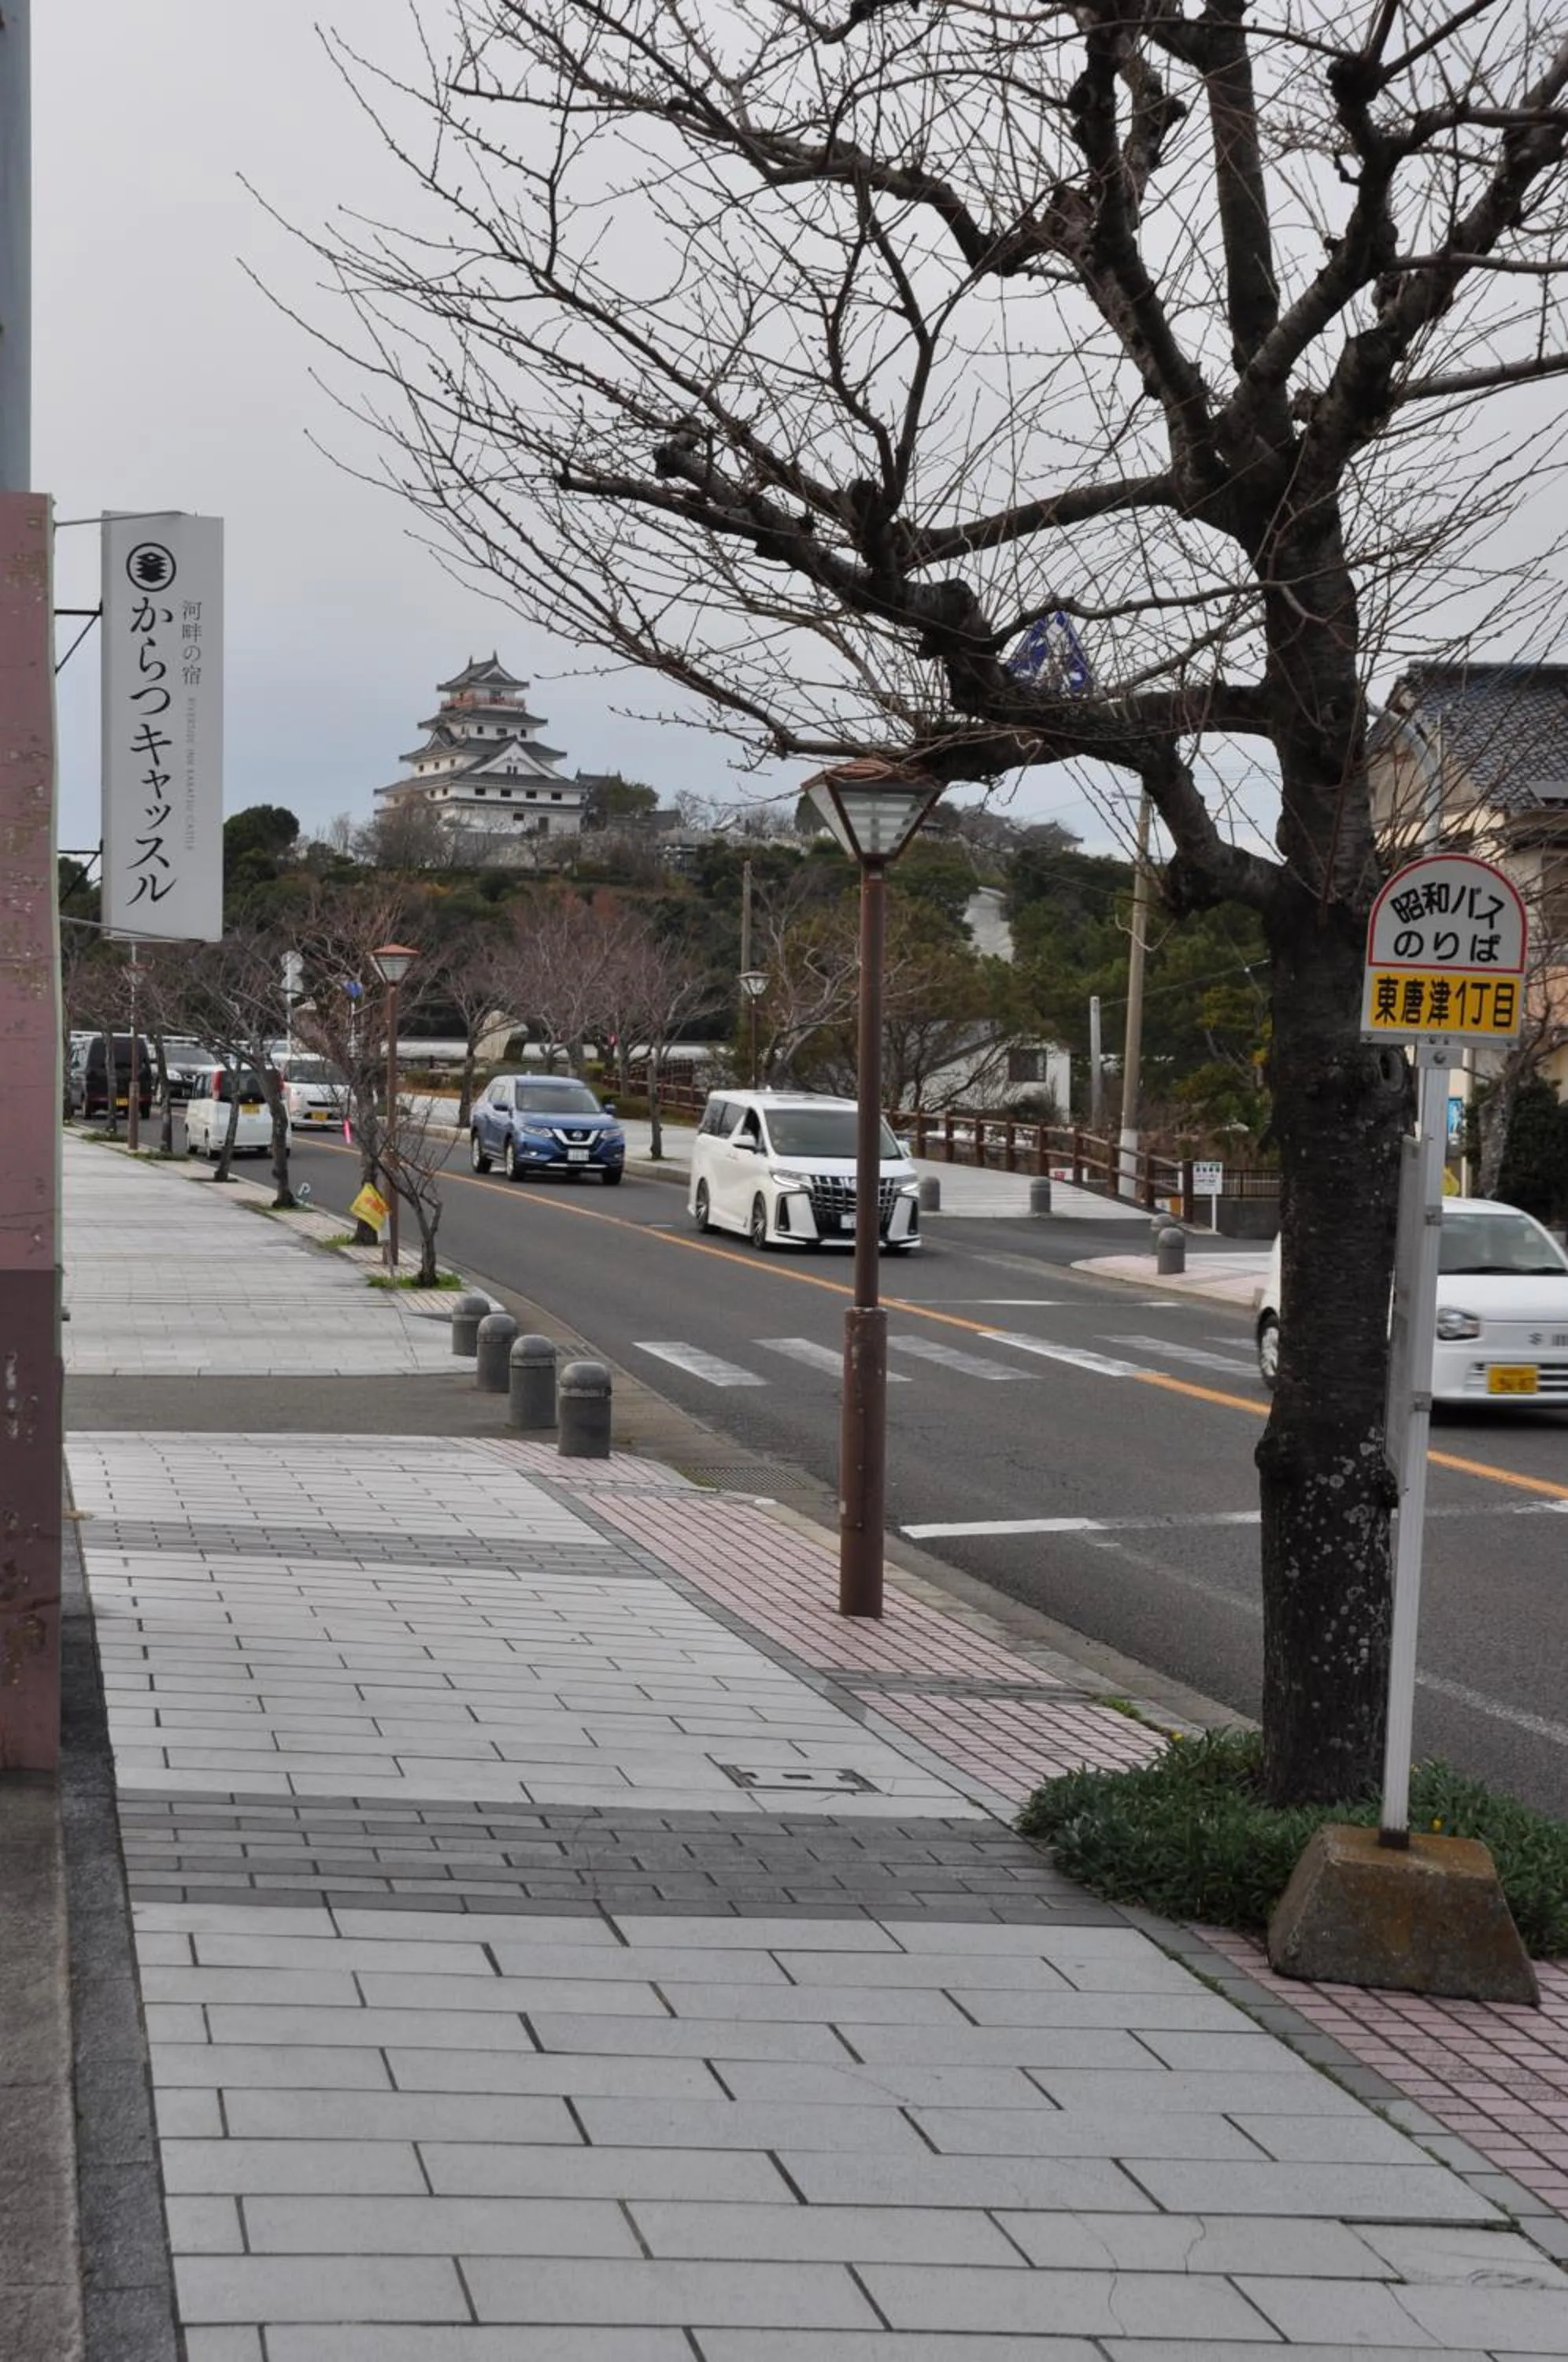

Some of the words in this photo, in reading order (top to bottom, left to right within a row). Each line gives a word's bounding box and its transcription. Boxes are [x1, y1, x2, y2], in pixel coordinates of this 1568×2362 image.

[180, 599, 203, 686] 河畔の宿
[126, 595, 177, 906] からつキャッスル
[1390, 882, 1506, 930] 昭和バス
[1393, 930, 1501, 962] のりば
